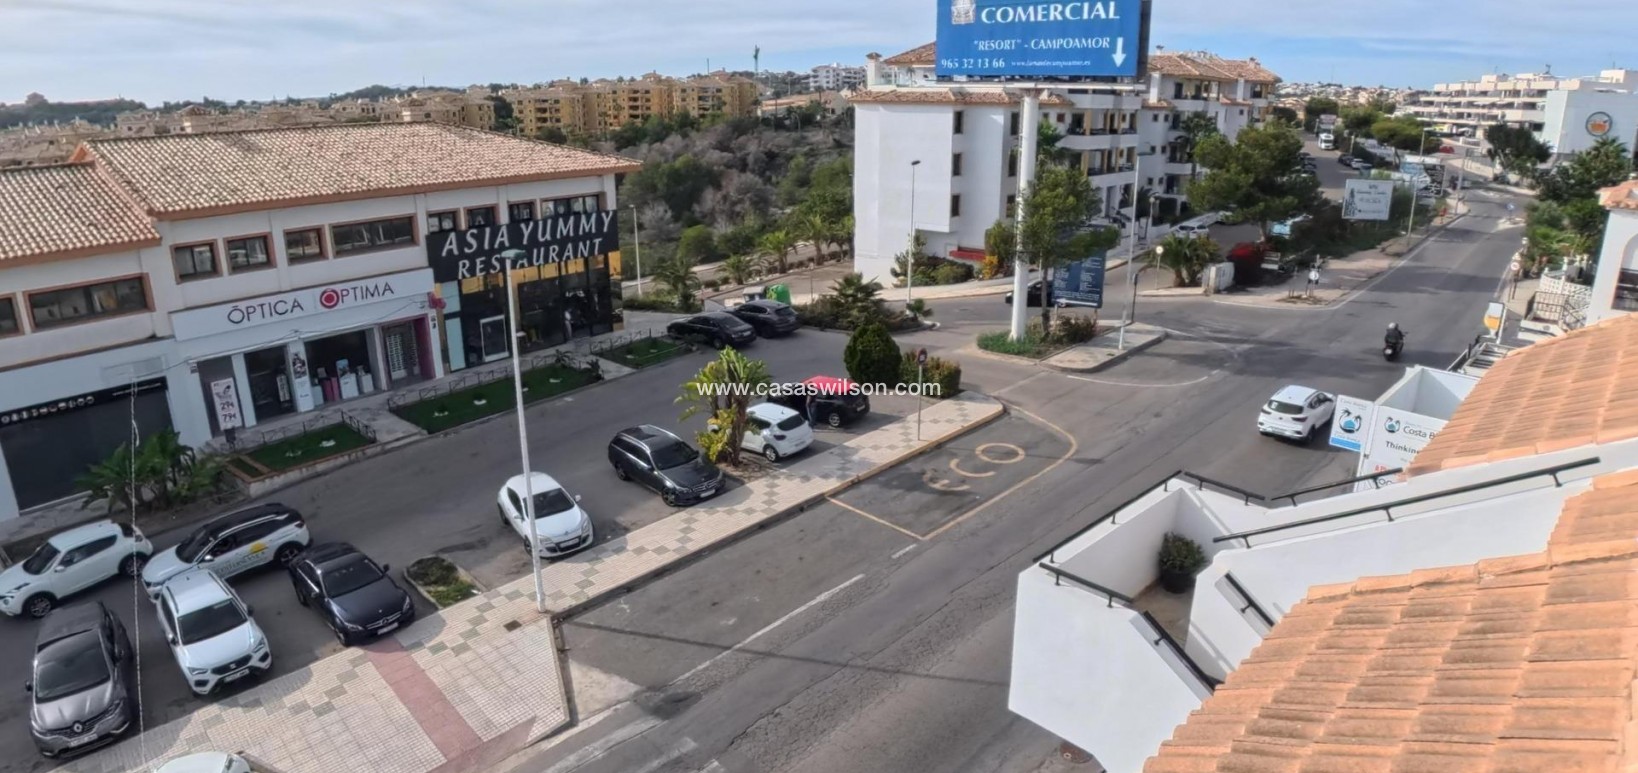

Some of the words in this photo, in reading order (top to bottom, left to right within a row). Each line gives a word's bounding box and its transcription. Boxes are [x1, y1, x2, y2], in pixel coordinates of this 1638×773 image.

[981, 1, 1120, 24] COMERCIAL
[1031, 37, 1110, 50] CAMPOAMOR
[941, 58, 959, 69] 965
[961, 58, 974, 69] 32
[978, 58, 989, 69] 13
[992, 58, 1005, 68] 66
[441, 224, 510, 257] ASIA
[520, 211, 613, 245] YUMMY
[458, 238, 603, 280] RESAURANT
[1403, 425, 1427, 438] Costa
